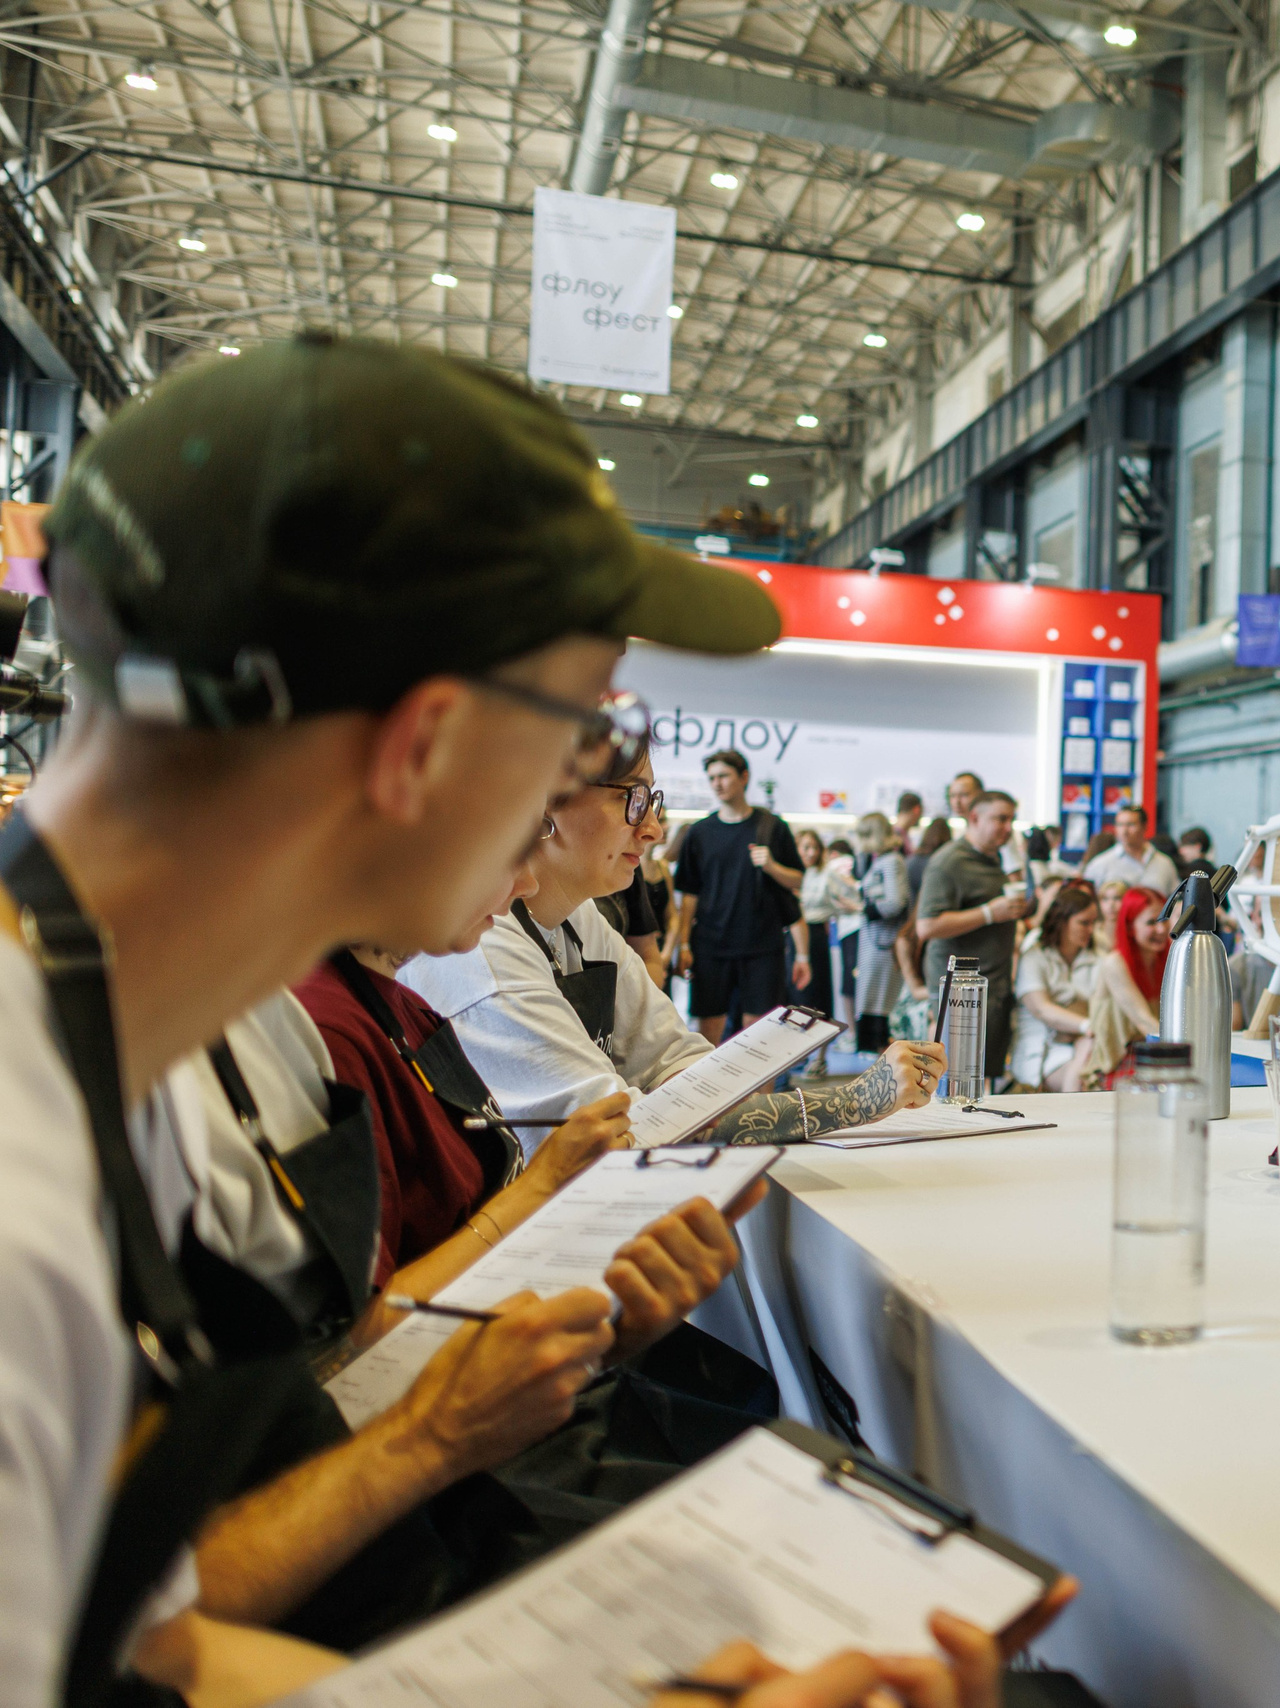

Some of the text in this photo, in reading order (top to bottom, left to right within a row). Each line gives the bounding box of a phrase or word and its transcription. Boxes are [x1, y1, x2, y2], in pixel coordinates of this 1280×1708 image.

[541, 270, 624, 305] флоу
[582, 304, 662, 333] фест
[652, 706, 799, 763] флоу
[948, 998, 982, 1009] WATER
